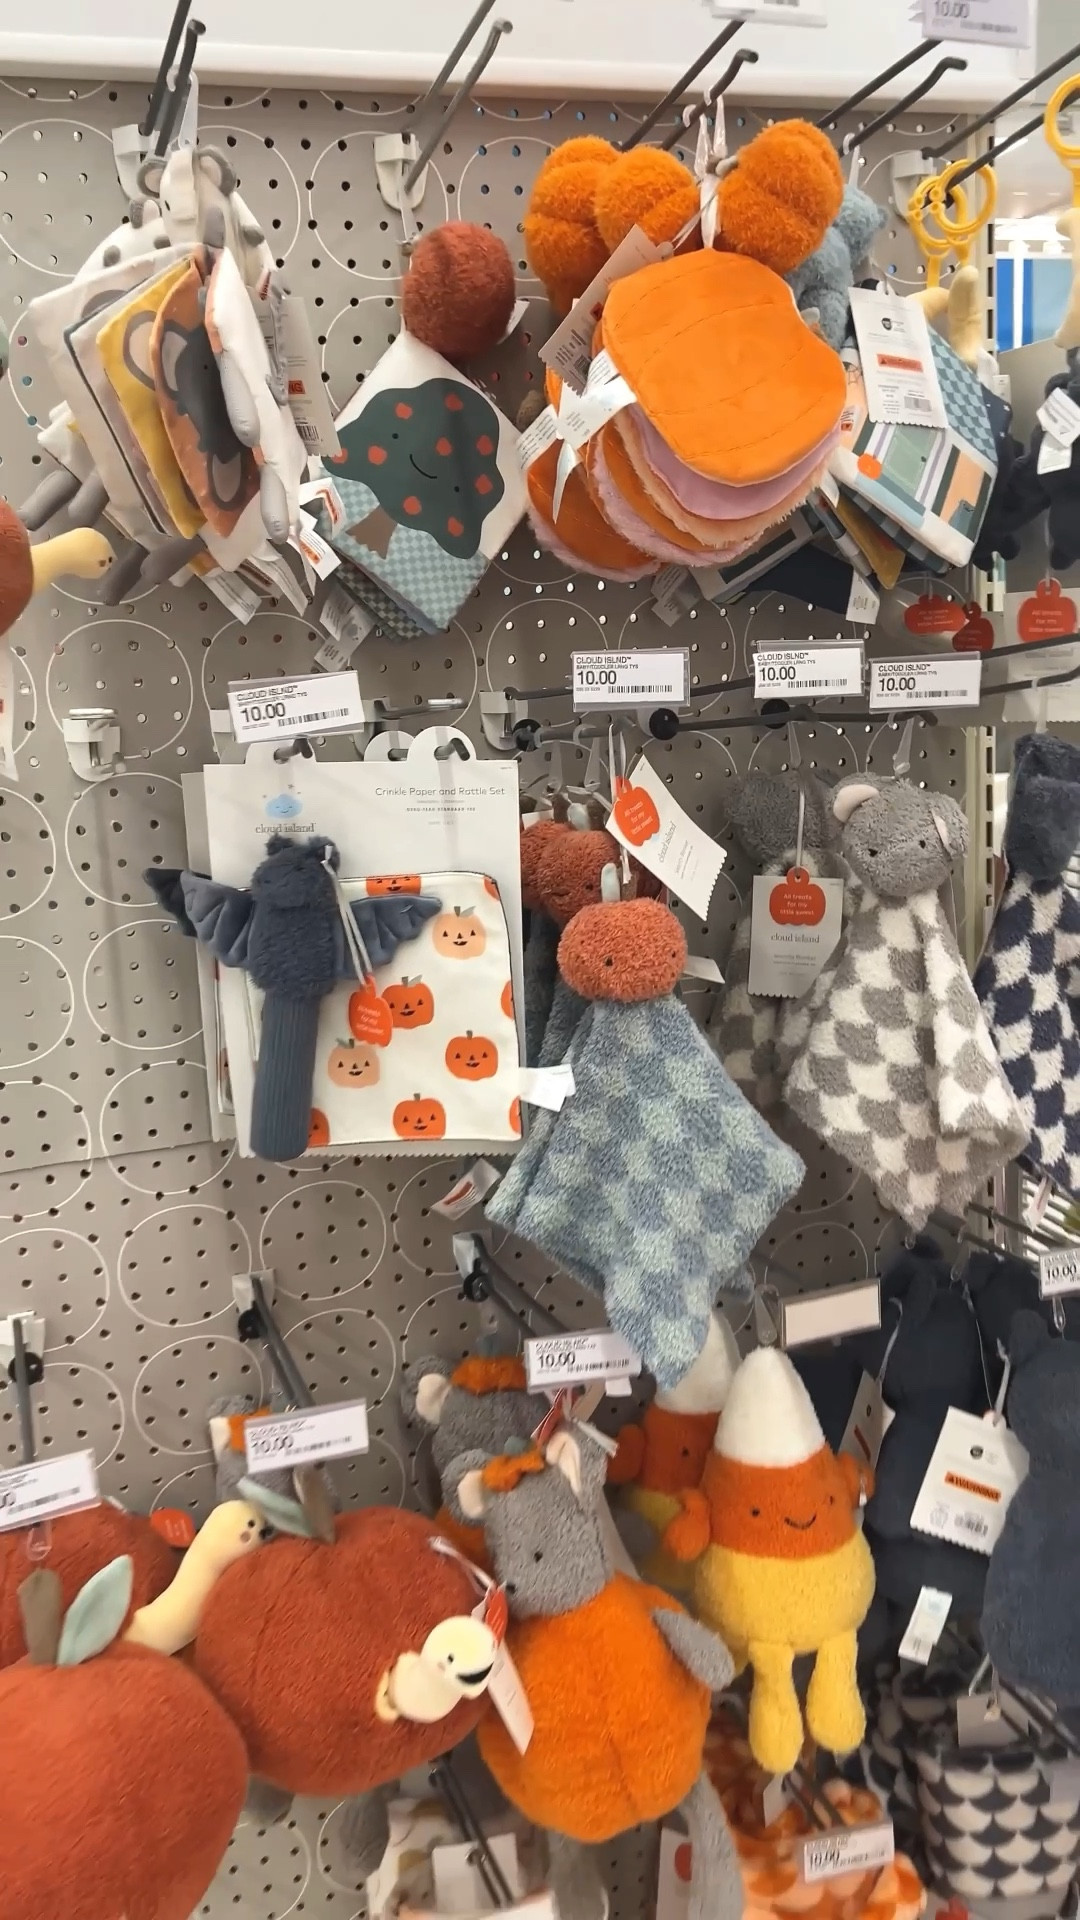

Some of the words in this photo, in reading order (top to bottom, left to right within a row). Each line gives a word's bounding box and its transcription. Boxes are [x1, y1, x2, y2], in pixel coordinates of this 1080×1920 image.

[576, 656, 603, 664] CLOUD
[757, 653, 783, 661] CLOUD
[759, 666, 796, 681] 10.00
[878, 664, 904, 672] CLOUD
[577, 670, 617, 685] 10.00
[879, 677, 916, 692] 10.00
[240, 702, 286, 722] 10.00
[375, 787, 407, 796] Crinkle
[409, 787, 436, 797] Paper
[439, 787, 456, 796] and
[459, 787, 487, 796] Rattle
[489, 786, 505, 796] Set
[255, 823, 282, 833] cloud
[283, 822, 315, 833] island
[771, 932, 793, 942] cloud
[794, 933, 820, 944] island
[538, 1351, 576, 1368] 10.00
